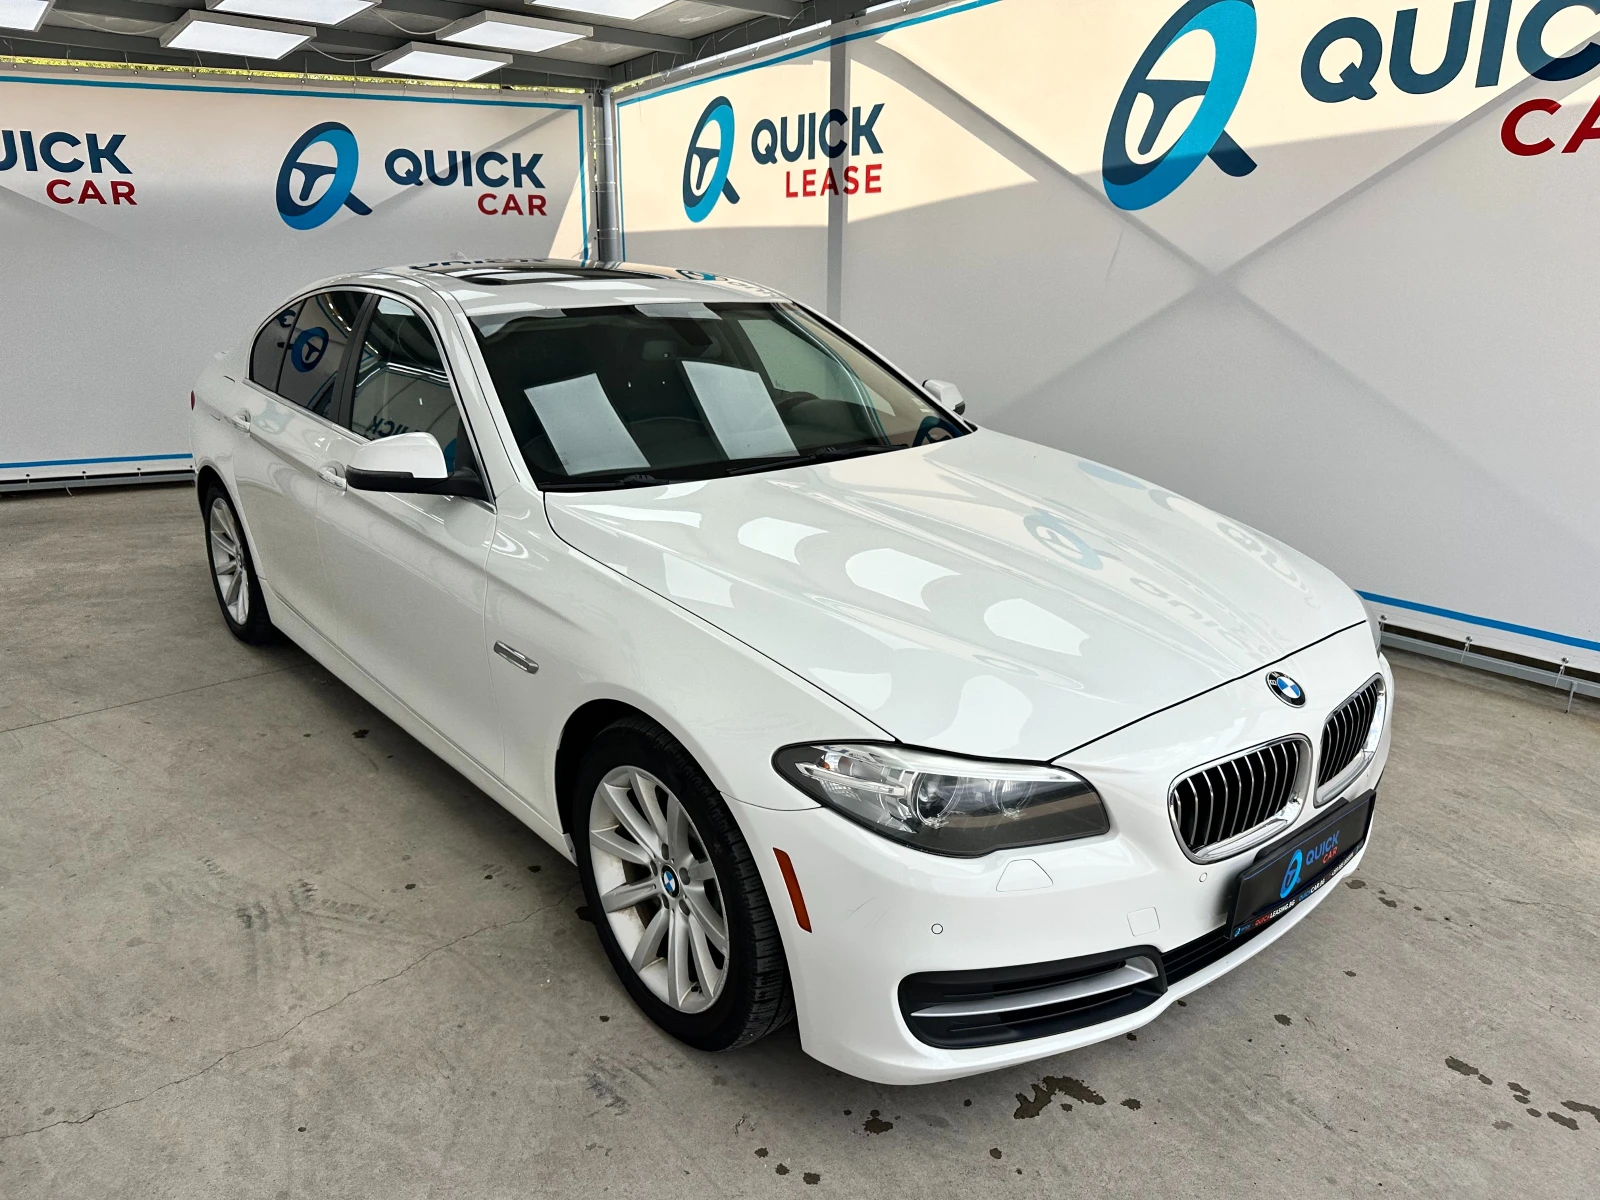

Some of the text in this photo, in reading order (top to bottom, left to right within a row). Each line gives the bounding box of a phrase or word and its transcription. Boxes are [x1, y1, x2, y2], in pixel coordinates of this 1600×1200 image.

[752, 103, 885, 164] QUICK
[385, 148, 546, 188] QUICK
[785, 164, 883, 199] LEASE
[46, 179, 138, 205] CAR
[477, 193, 547, 216] CAR
[1306, 830, 1340, 865] QUICK
[1322, 846, 1338, 864] CAR
